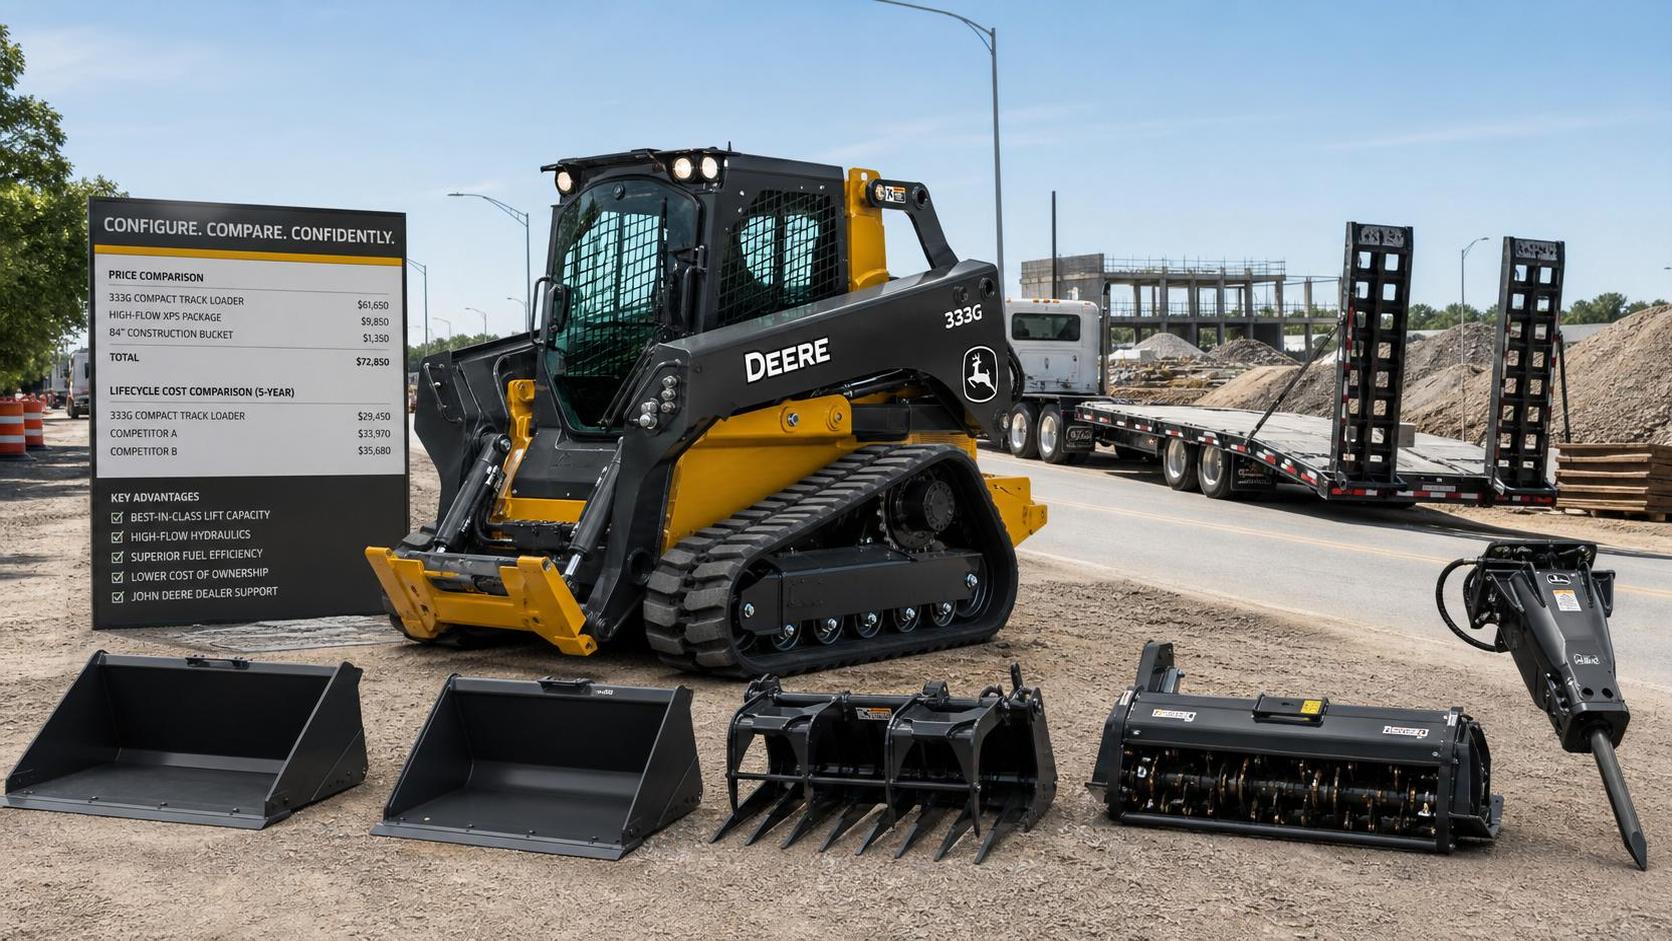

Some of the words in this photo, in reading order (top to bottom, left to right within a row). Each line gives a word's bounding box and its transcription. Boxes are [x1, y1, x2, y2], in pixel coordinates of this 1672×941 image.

[103, 216, 202, 236] CONFIGURE.
[206, 221, 287, 239] COMPARE.
[291, 225, 395, 244] CONFIDENTLY.
[108, 269, 137, 280] PRICE
[138, 270, 204, 282] COMPARISON
[108, 292, 132, 303] 333G
[133, 293, 177, 304] COMPACT
[178, 294, 208, 305] TRACK
[209, 295, 244, 306] LOADER
[357, 299, 389, 311] $61,650
[108, 309, 161, 320] HIGH-FLOW
[162, 311, 180, 321] XPS
[181, 311, 222, 322] PACKAGE
[360, 315, 389, 327] $9,850
[944, 304, 982, 329] 333G
[126, 327, 197, 339] CONSTRUCTION
[198, 329, 234, 339] BUCKET
[362, 332, 390, 344] $1,350
[108, 352, 140, 362] TOTAL
[355, 356, 390, 367] $72,850
[745, 337, 831, 383] DEERE
[109, 385, 160, 396] LIFECYCLE
[161, 386, 187, 396] COST
[188, 386, 253, 397] COMPARISON
[254, 386, 295, 398] (5-YEAR)
[109, 410, 133, 420] 333G
[134, 410, 179, 420] COMPACT
[179, 410, 209, 421] TRACK
[210, 410, 245, 420] LOADER
[357, 410, 391, 422] $29,450
[109, 428, 169, 438] COMPETITOR
[169, 428, 178, 438] A
[357, 428, 391, 439] $33,970
[109, 446, 169, 456] COMPETITOR
[170, 446, 178, 456] B
[357, 445, 391, 456] $35,680
[110, 492, 131, 503] KEY
[132, 491, 200, 502] ADVANTAGES
[130, 510, 202, 522] BEST-IN-CLASS
[203, 510, 224, 521] LIFT
[225, 509, 271, 520] CAPACITY
[130, 530, 188, 542] HIGH-FLOW
[190, 528, 251, 540] HYDRAULICS
[130, 550, 180, 562] SUPERIOR
[182, 549, 207, 561] FUEL
[208, 548, 263, 560] EFFICIENCY
[130, 570, 167, 582] LOWER
[168, 569, 194, 581] COST
[195, 569, 209, 580] OF
[211, 567, 269, 579] OWNERSHIP
[130, 590, 159, 602] JOHN
[161, 589, 193, 600] DEERE
[195, 587, 233, 599] DEALER
[234, 585, 278, 597] SUPPORT
